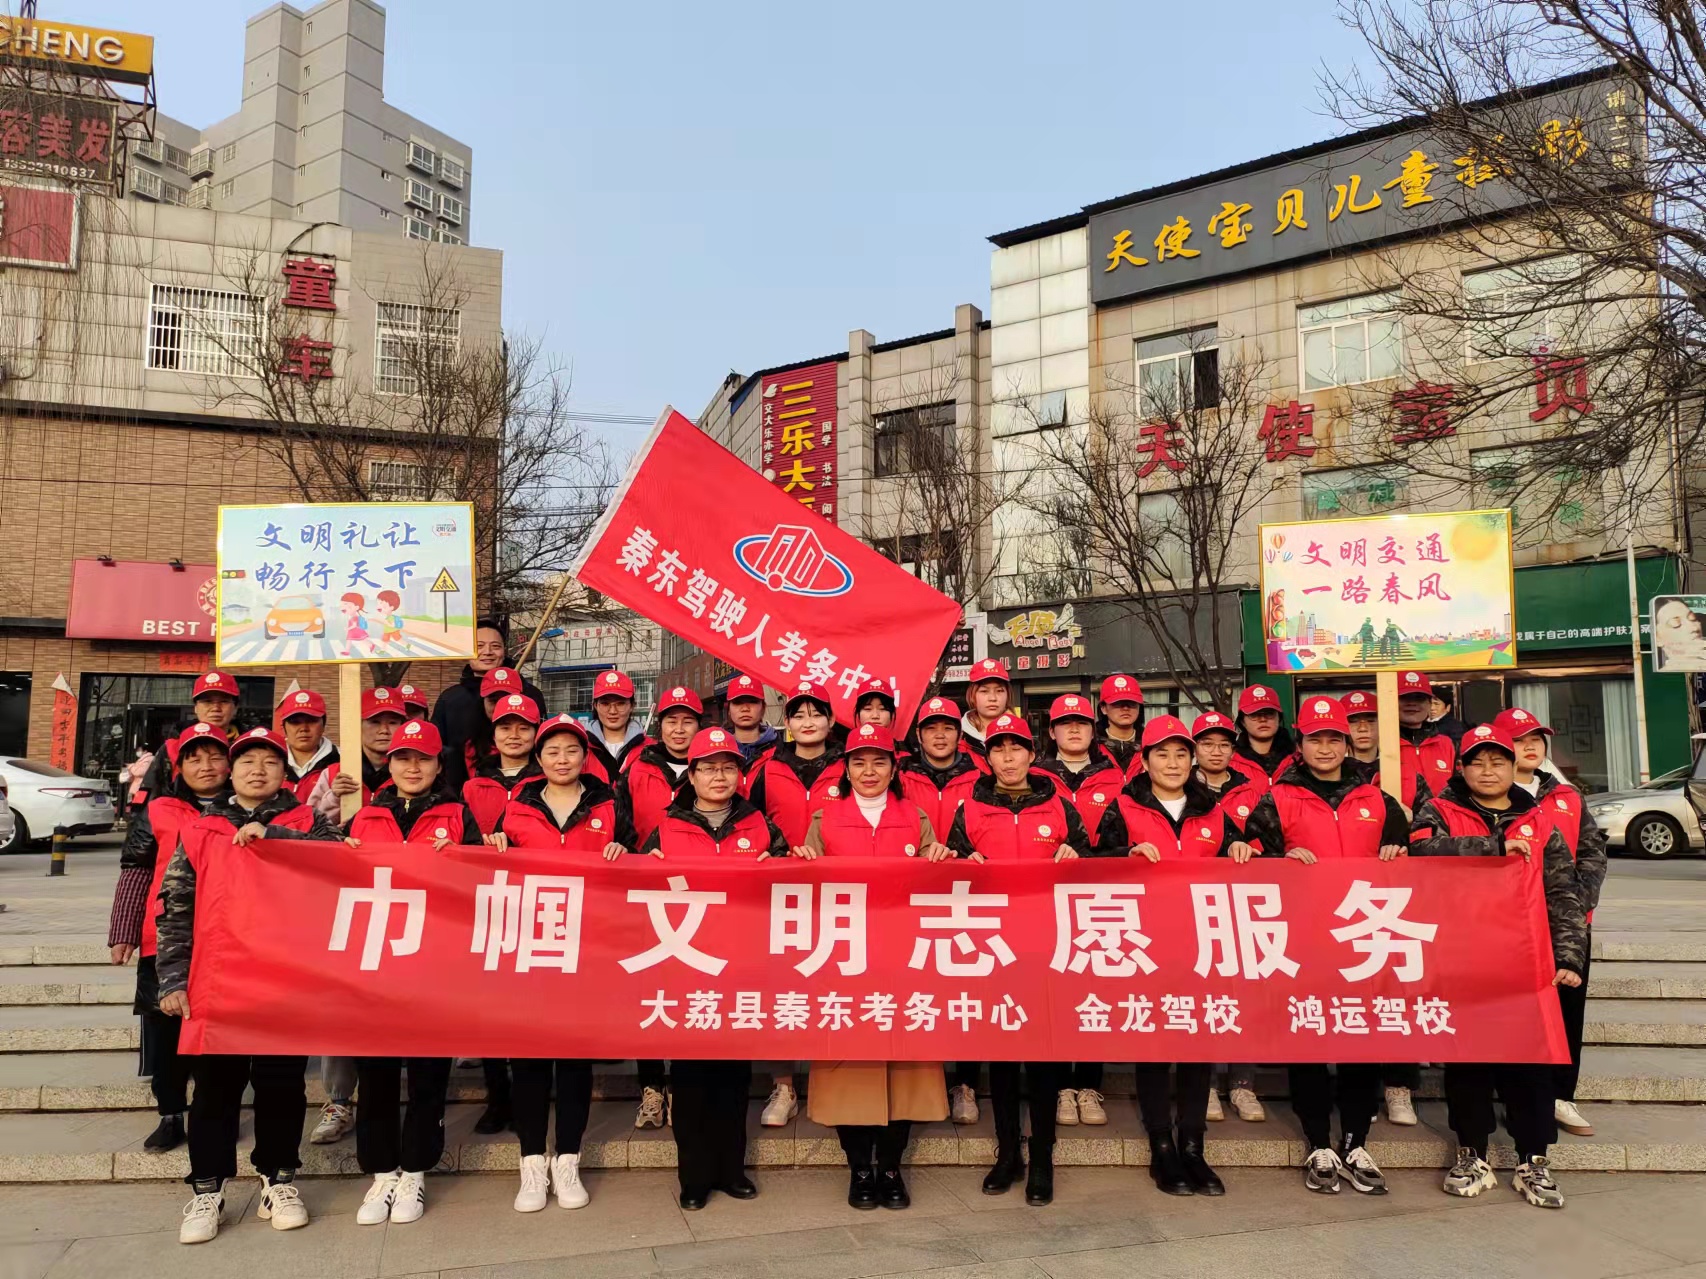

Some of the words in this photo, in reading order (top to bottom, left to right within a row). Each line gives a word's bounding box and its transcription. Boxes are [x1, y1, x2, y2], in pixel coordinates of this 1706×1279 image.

[280, 257, 336, 383] 童车
[821, 421, 832, 446] 国学
[256, 521, 420, 551] 文明礼让
[1300, 532, 1450, 568] 文明交通
[255, 560, 417, 591] 畅行天下
[1301, 572, 1452, 605] 一路春风
[142, 619, 200, 636] BEST
[328, 866, 1438, 983] 巾帼文明志愿服务
[639, 990, 1029, 1032] 大荔县秦东考务中心
[1074, 993, 1242, 1035] 金龙驾校
[1287, 995, 1457, 1036] 鸿运驾校
